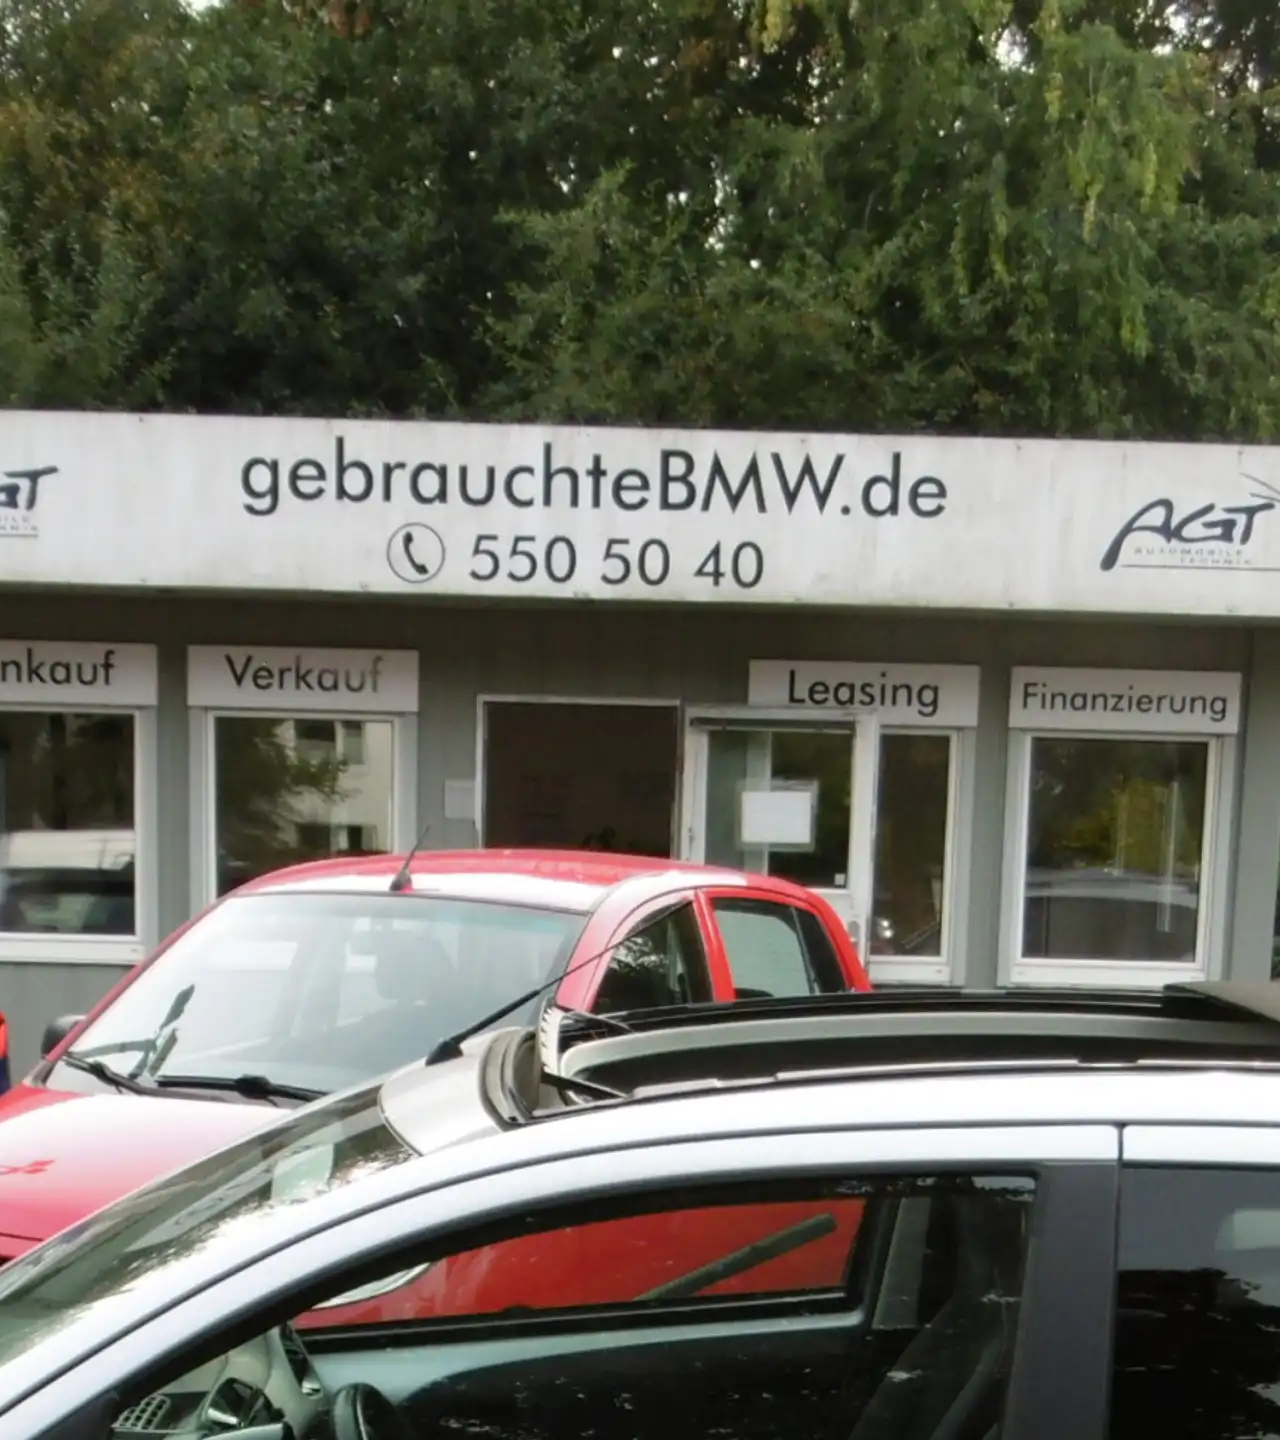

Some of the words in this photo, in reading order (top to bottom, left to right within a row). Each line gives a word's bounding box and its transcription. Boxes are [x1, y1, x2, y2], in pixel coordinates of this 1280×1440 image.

[241, 437, 948, 518] gebrauchteBMW.de
[1100, 497, 1276, 571] AGT
[470, 534, 576, 584] 550
[600, 538, 670, 587] 50
[693, 540, 765, 588] 40
[225, 654, 383, 693] Verkauf
[788, 669, 940, 717] Leasing
[1023, 682, 1228, 720] Finanzierung
